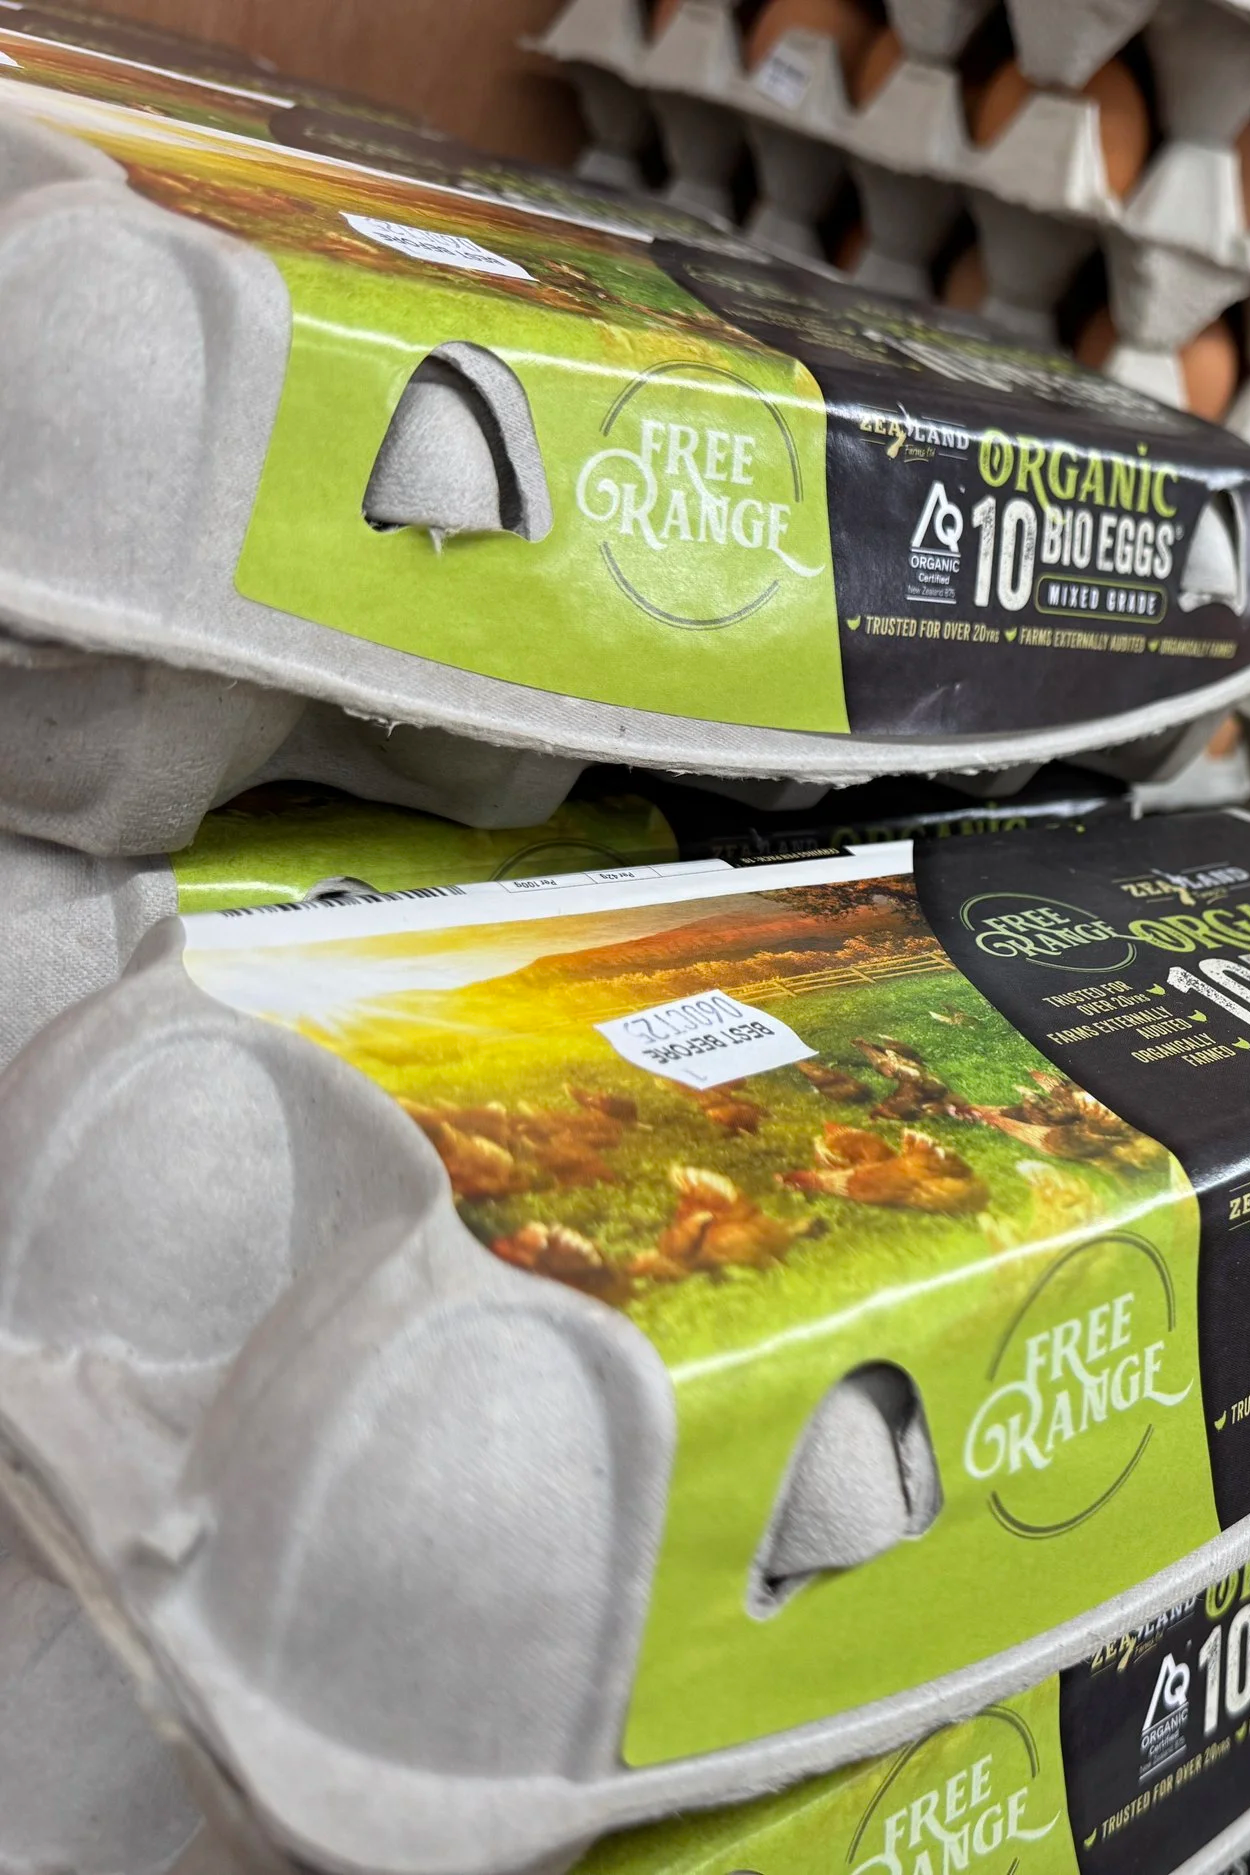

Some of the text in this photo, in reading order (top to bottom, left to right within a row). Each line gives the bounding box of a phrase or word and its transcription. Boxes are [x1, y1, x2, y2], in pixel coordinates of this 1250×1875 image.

[639, 418, 757, 487] FREE
[978, 427, 1179, 519] ORGANIC
[575, 448, 826, 577] RANGE
[909, 555, 961, 573] ORGANIC
[972, 495, 1038, 613] 10
[1040, 504, 1094, 570] BIO
[918, 572, 950, 585] Certified
[1047, 584, 1158, 616] MIXED GRADE
[865, 615, 917, 638] TRUSTED
[919, 620, 941, 640] FOR
[943, 622, 971, 642] OVER
[975, 920, 1144, 958] RANGE
[981, 907, 1072, 934] FREE
[1041, 980, 1134, 1008] TRUSTED FOR
[1076, 998, 1118, 1017] OVER
[641, 1021, 776, 1065] BEST BEFORE
[1046, 1005, 1174, 1045] FARMS EXTERNALLY
[1135, 1018, 1193, 1040] AUDITED
[1130, 1032, 1217, 1064] ORGANICALLY
[1181, 1045, 1237, 1067] FARMED
[1025, 1292, 1135, 1382] FREE
[963, 1340, 1195, 1481] RANGE
[1140, 1707, 1189, 1751] ORGANIC
[884, 1753, 994, 1848] FREE
[1101, 1789, 1151, 1840] TRUSTED
[1152, 1774, 1174, 1805] FOR
[1175, 1752, 1203, 1788] OVER
